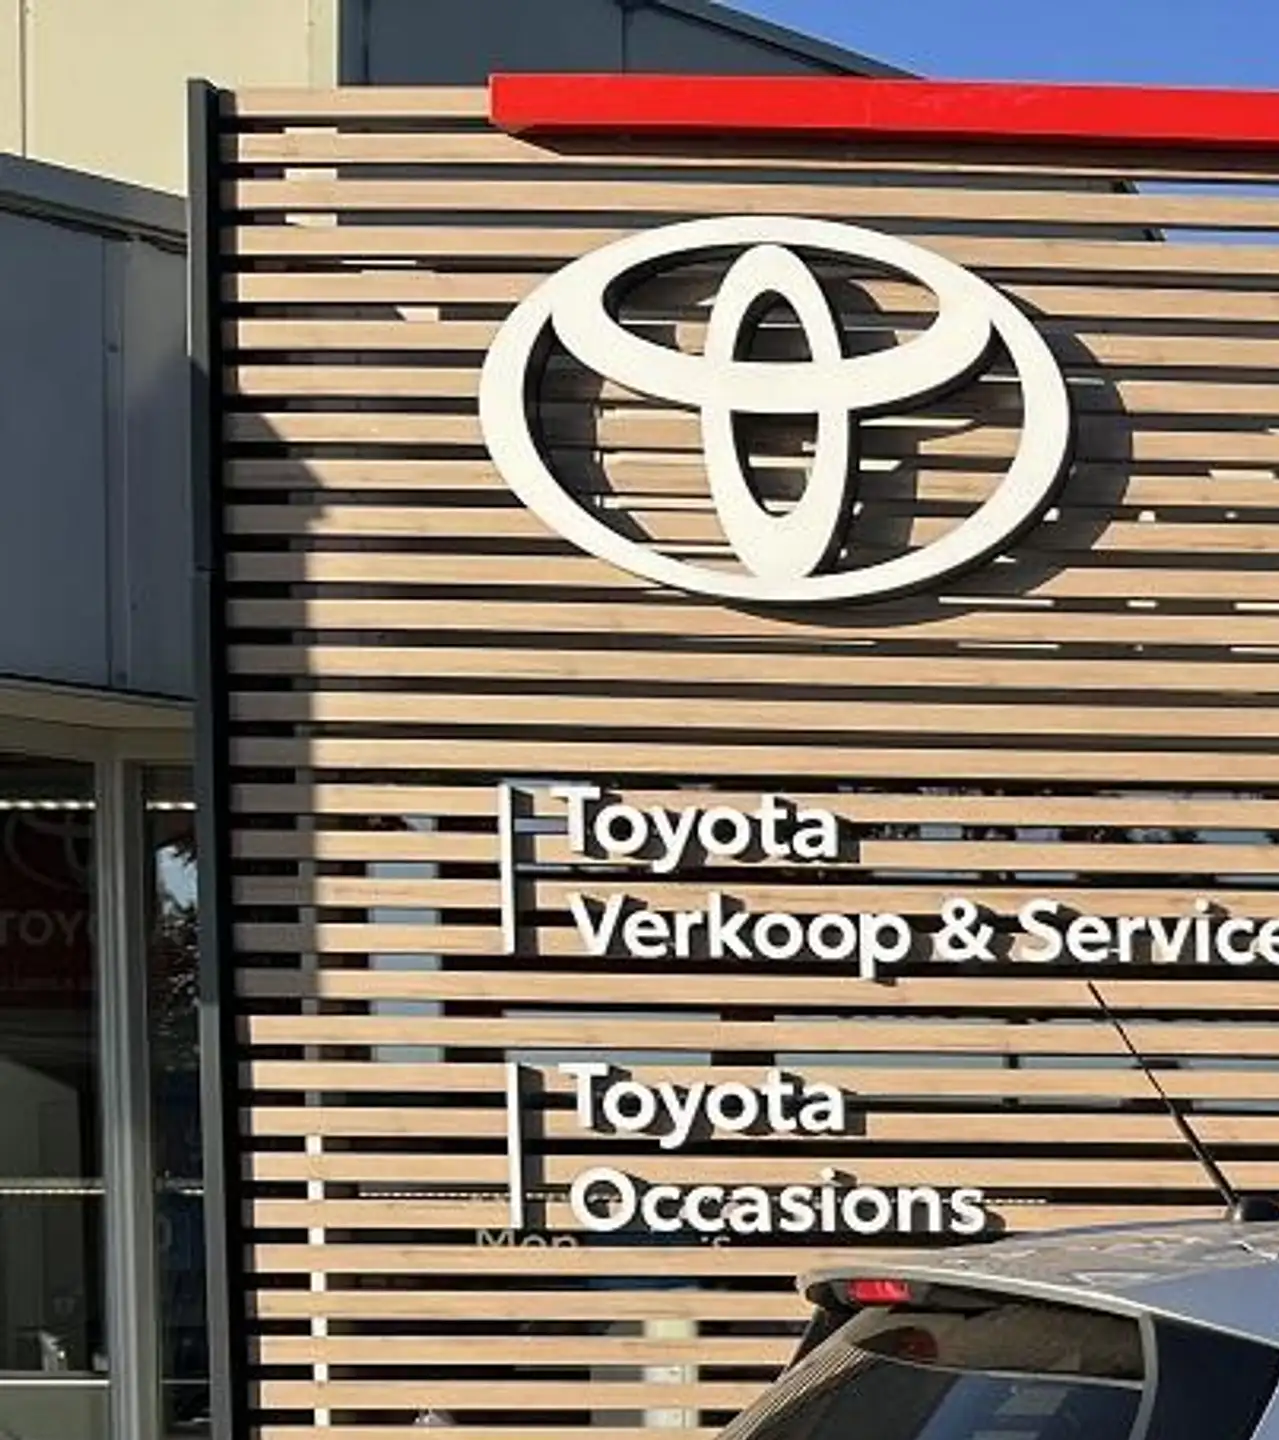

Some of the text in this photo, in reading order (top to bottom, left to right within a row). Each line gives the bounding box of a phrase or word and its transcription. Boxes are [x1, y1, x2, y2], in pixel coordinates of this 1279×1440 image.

[550, 786, 838, 874] Toyota
[568, 892, 912, 979] Verkoop
[935, 897, 997, 963] &
[559, 1063, 846, 1149] Toyota
[570, 1167, 987, 1235] Occasions
